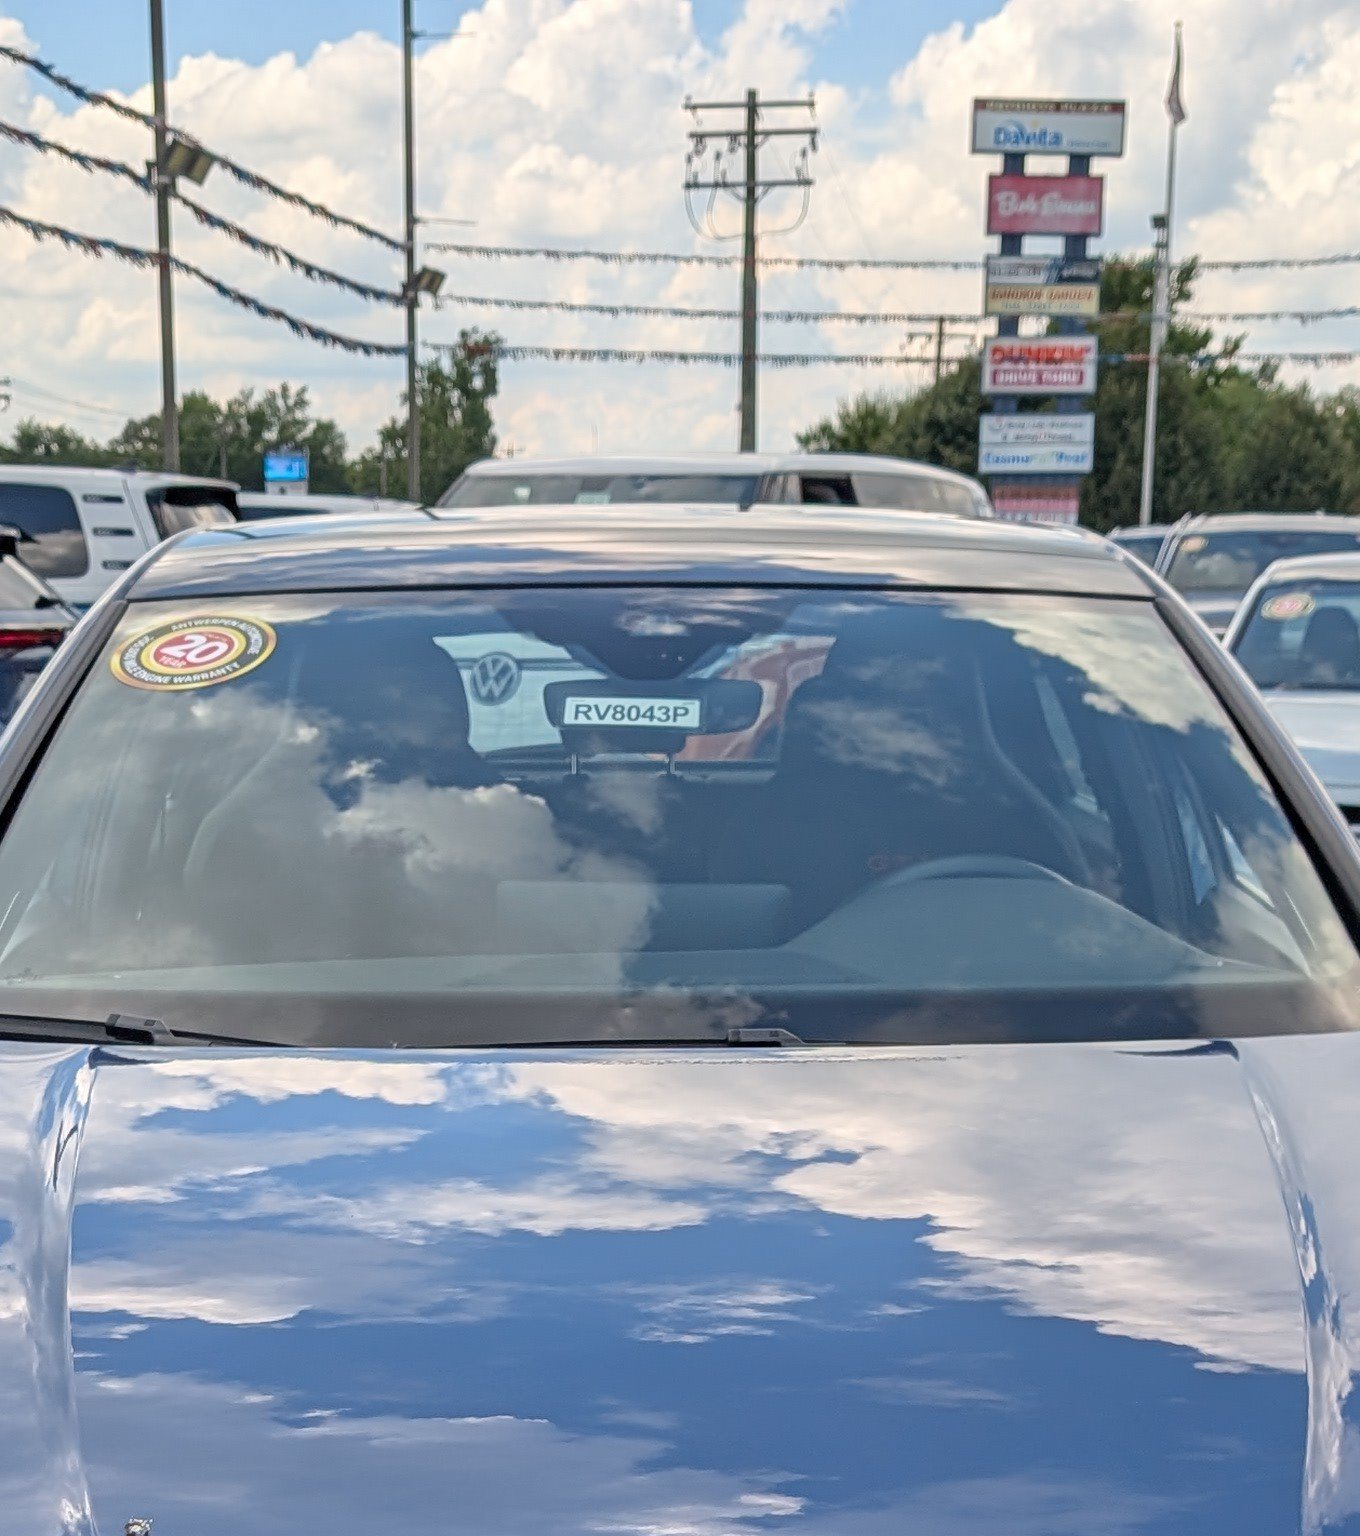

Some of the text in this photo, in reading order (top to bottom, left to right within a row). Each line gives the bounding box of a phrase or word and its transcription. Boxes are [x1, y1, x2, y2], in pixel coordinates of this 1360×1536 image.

[160, 633, 229, 664] 20
[173, 662, 240, 683] WARRANTY
[574, 704, 690, 723] RV8043P
